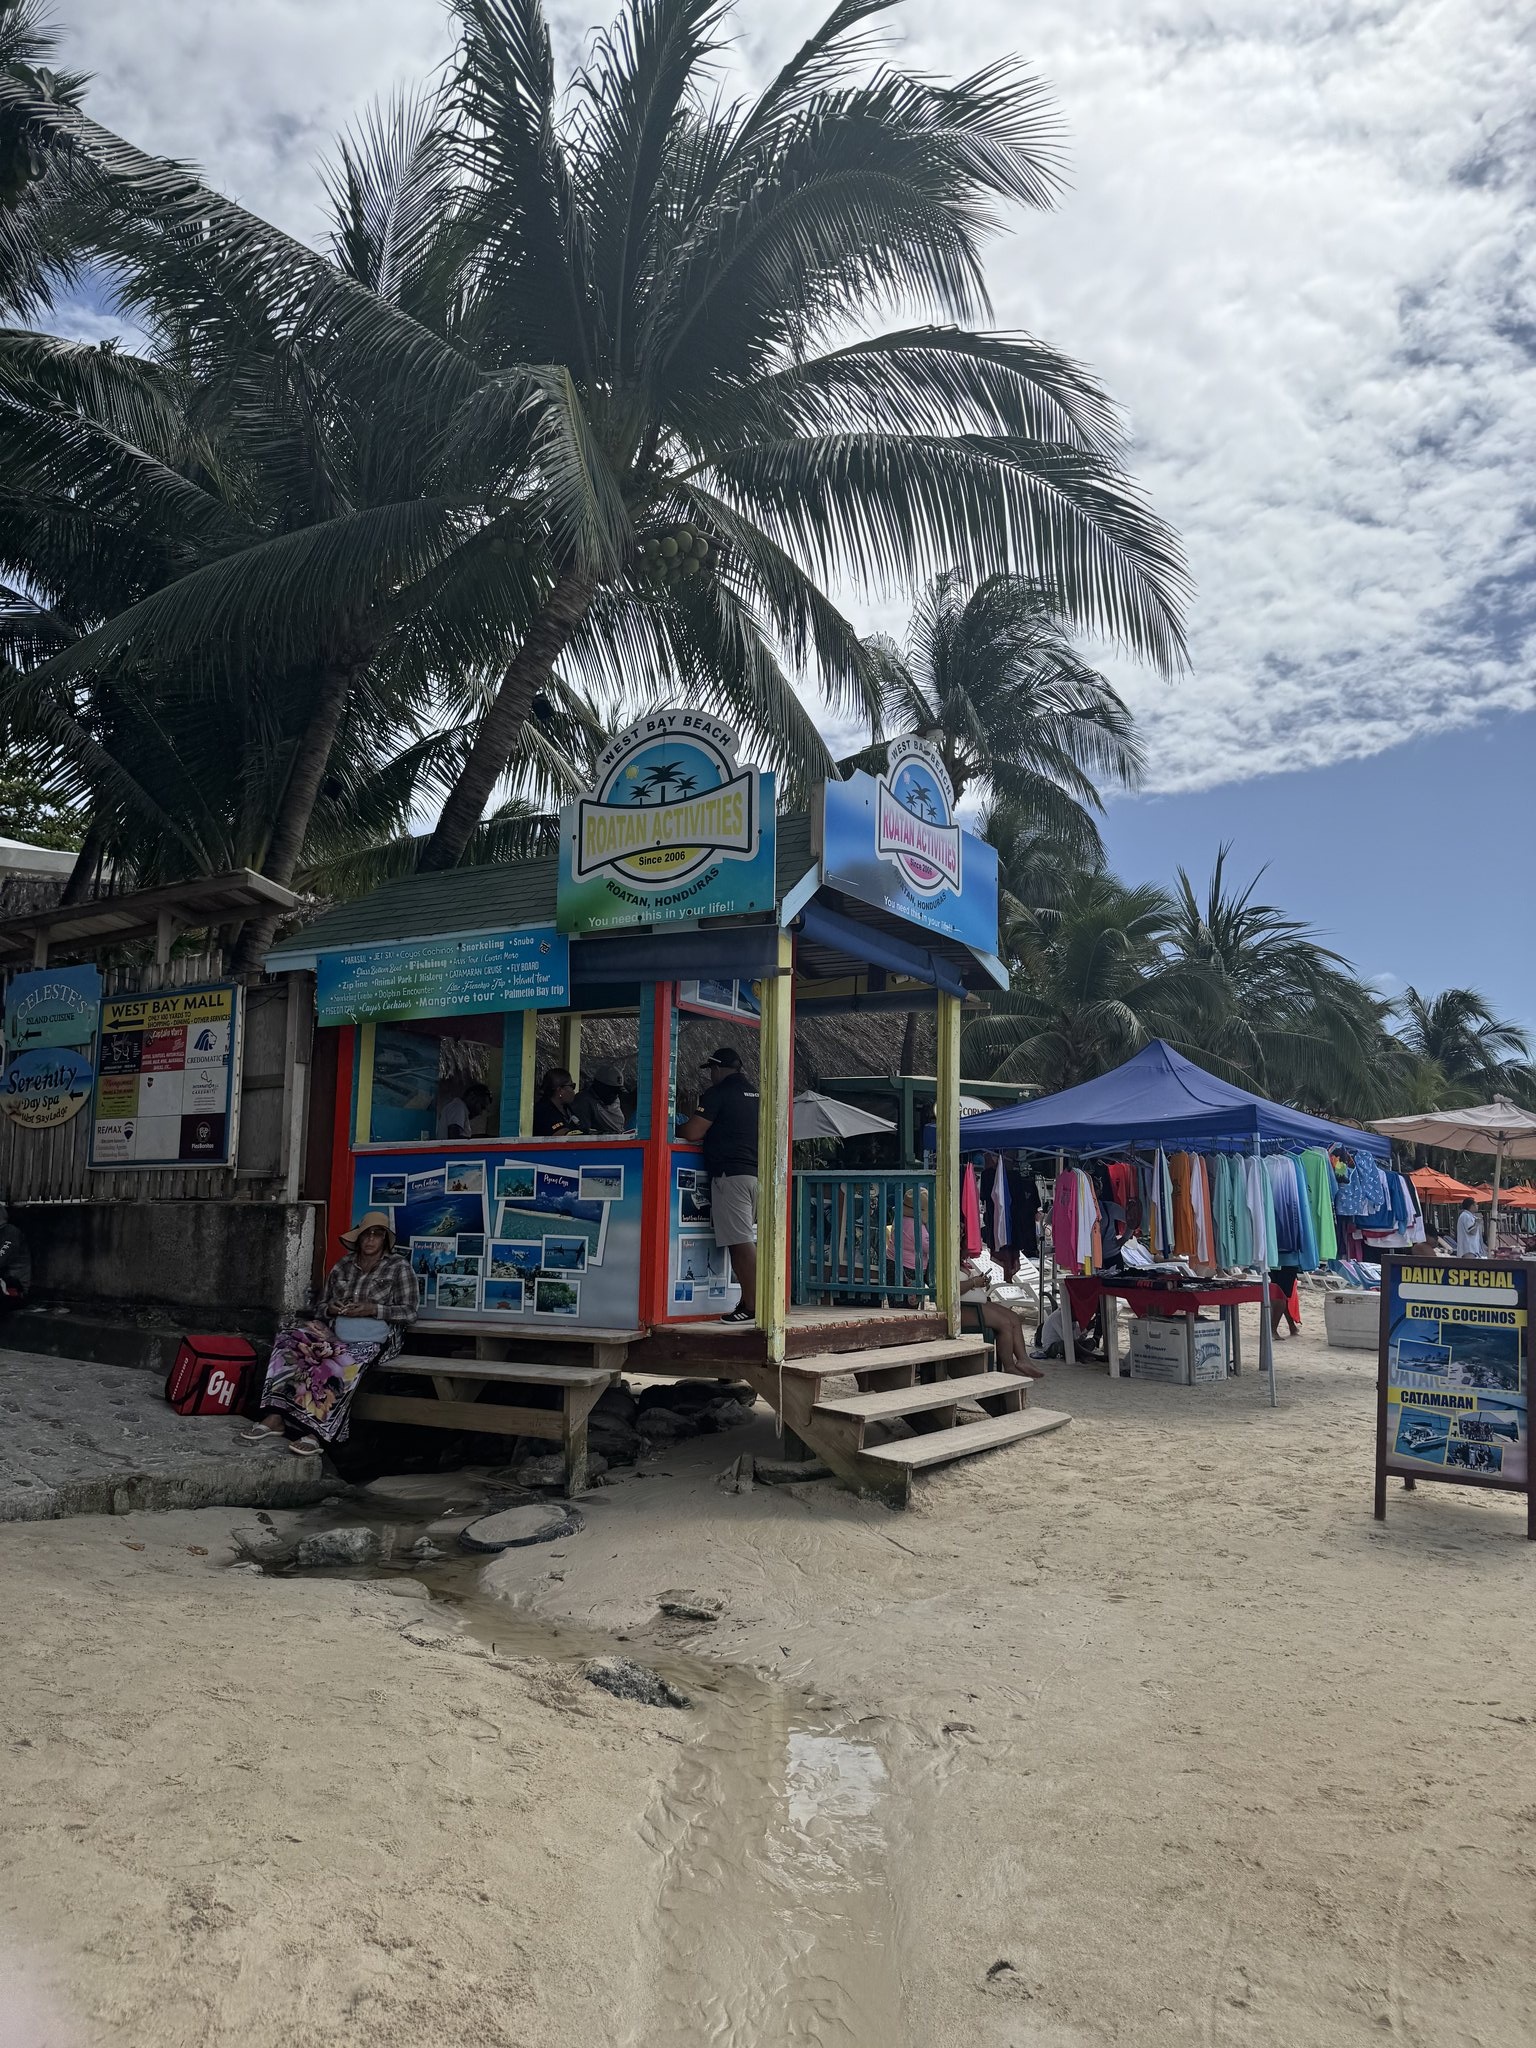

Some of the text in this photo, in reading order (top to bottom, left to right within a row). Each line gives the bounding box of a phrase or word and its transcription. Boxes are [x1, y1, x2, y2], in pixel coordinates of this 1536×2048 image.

[602, 716, 731, 765] WEST BAY BEACH
[891, 740, 910, 760] WEST
[930, 753, 951, 795] BEACH
[586, 791, 743, 858] ROATAN ACTIVITIES
[639, 851, 686, 866] Since 2006
[916, 827, 956, 874] ACTIVITIES
[606, 867, 719, 909] ROATAN, HONDURAS
[884, 895, 895, 908] You
[896, 903, 909, 914] need
[911, 906, 921, 918] this
[927, 916, 941, 927] your
[918, 892, 946, 910] HONDURAS
[588, 901, 734, 927] You need this in your life!!
[373, 953, 383, 961] JET
[400, 950, 420, 959] Cayos
[423, 946, 453, 956] Cochinos
[462, 939, 504, 952] Snorkeling
[342, 981, 353, 991] Zip
[375, 976, 396, 986] Animal
[398, 974, 412, 984] Park
[419, 972, 443, 982] History
[449, 967, 482, 979] CATAMARAN
[483, 965, 503, 975] CRUISE
[510, 963, 520, 972] FLY
[520, 961, 540, 971] BOARD
[409, 959, 447, 970] Fishing
[379, 990, 401, 1000] Dolphin
[403, 986, 434, 995] Encounter
[513, 974, 535, 986] Island
[17, 983, 87, 1019] CELESTE'S
[112, 994, 224, 1017] WEST BAY MALL
[362, 1002, 381, 1016] Cayos
[383, 1000, 412, 1010] Cochinos
[420, 995, 470, 1007] Mangrove
[473, 992, 495, 1002] tour
[504, 988, 535, 999] Palmetto
[536, 987, 550, 997] Bay
[551, 984, 564, 996] trip
[26, 1012, 75, 1025] ISLAND CUISINE
[187, 1055, 222, 1065] CREDOMATIC
[7, 1065, 77, 1094] Serenity
[22, 1095, 60, 1112] Day Spa
[36, 1114, 50, 1124] Bay
[98, 1126, 122, 1134] RE/MAX
[1401, 1266, 1515, 1288] DAILY SPECIAL
[1411, 1305, 1516, 1324] CAYOS COCHINOS
[207, 1370, 235, 1407] GH
[1401, 1391, 1473, 1410] CATAMARAN
